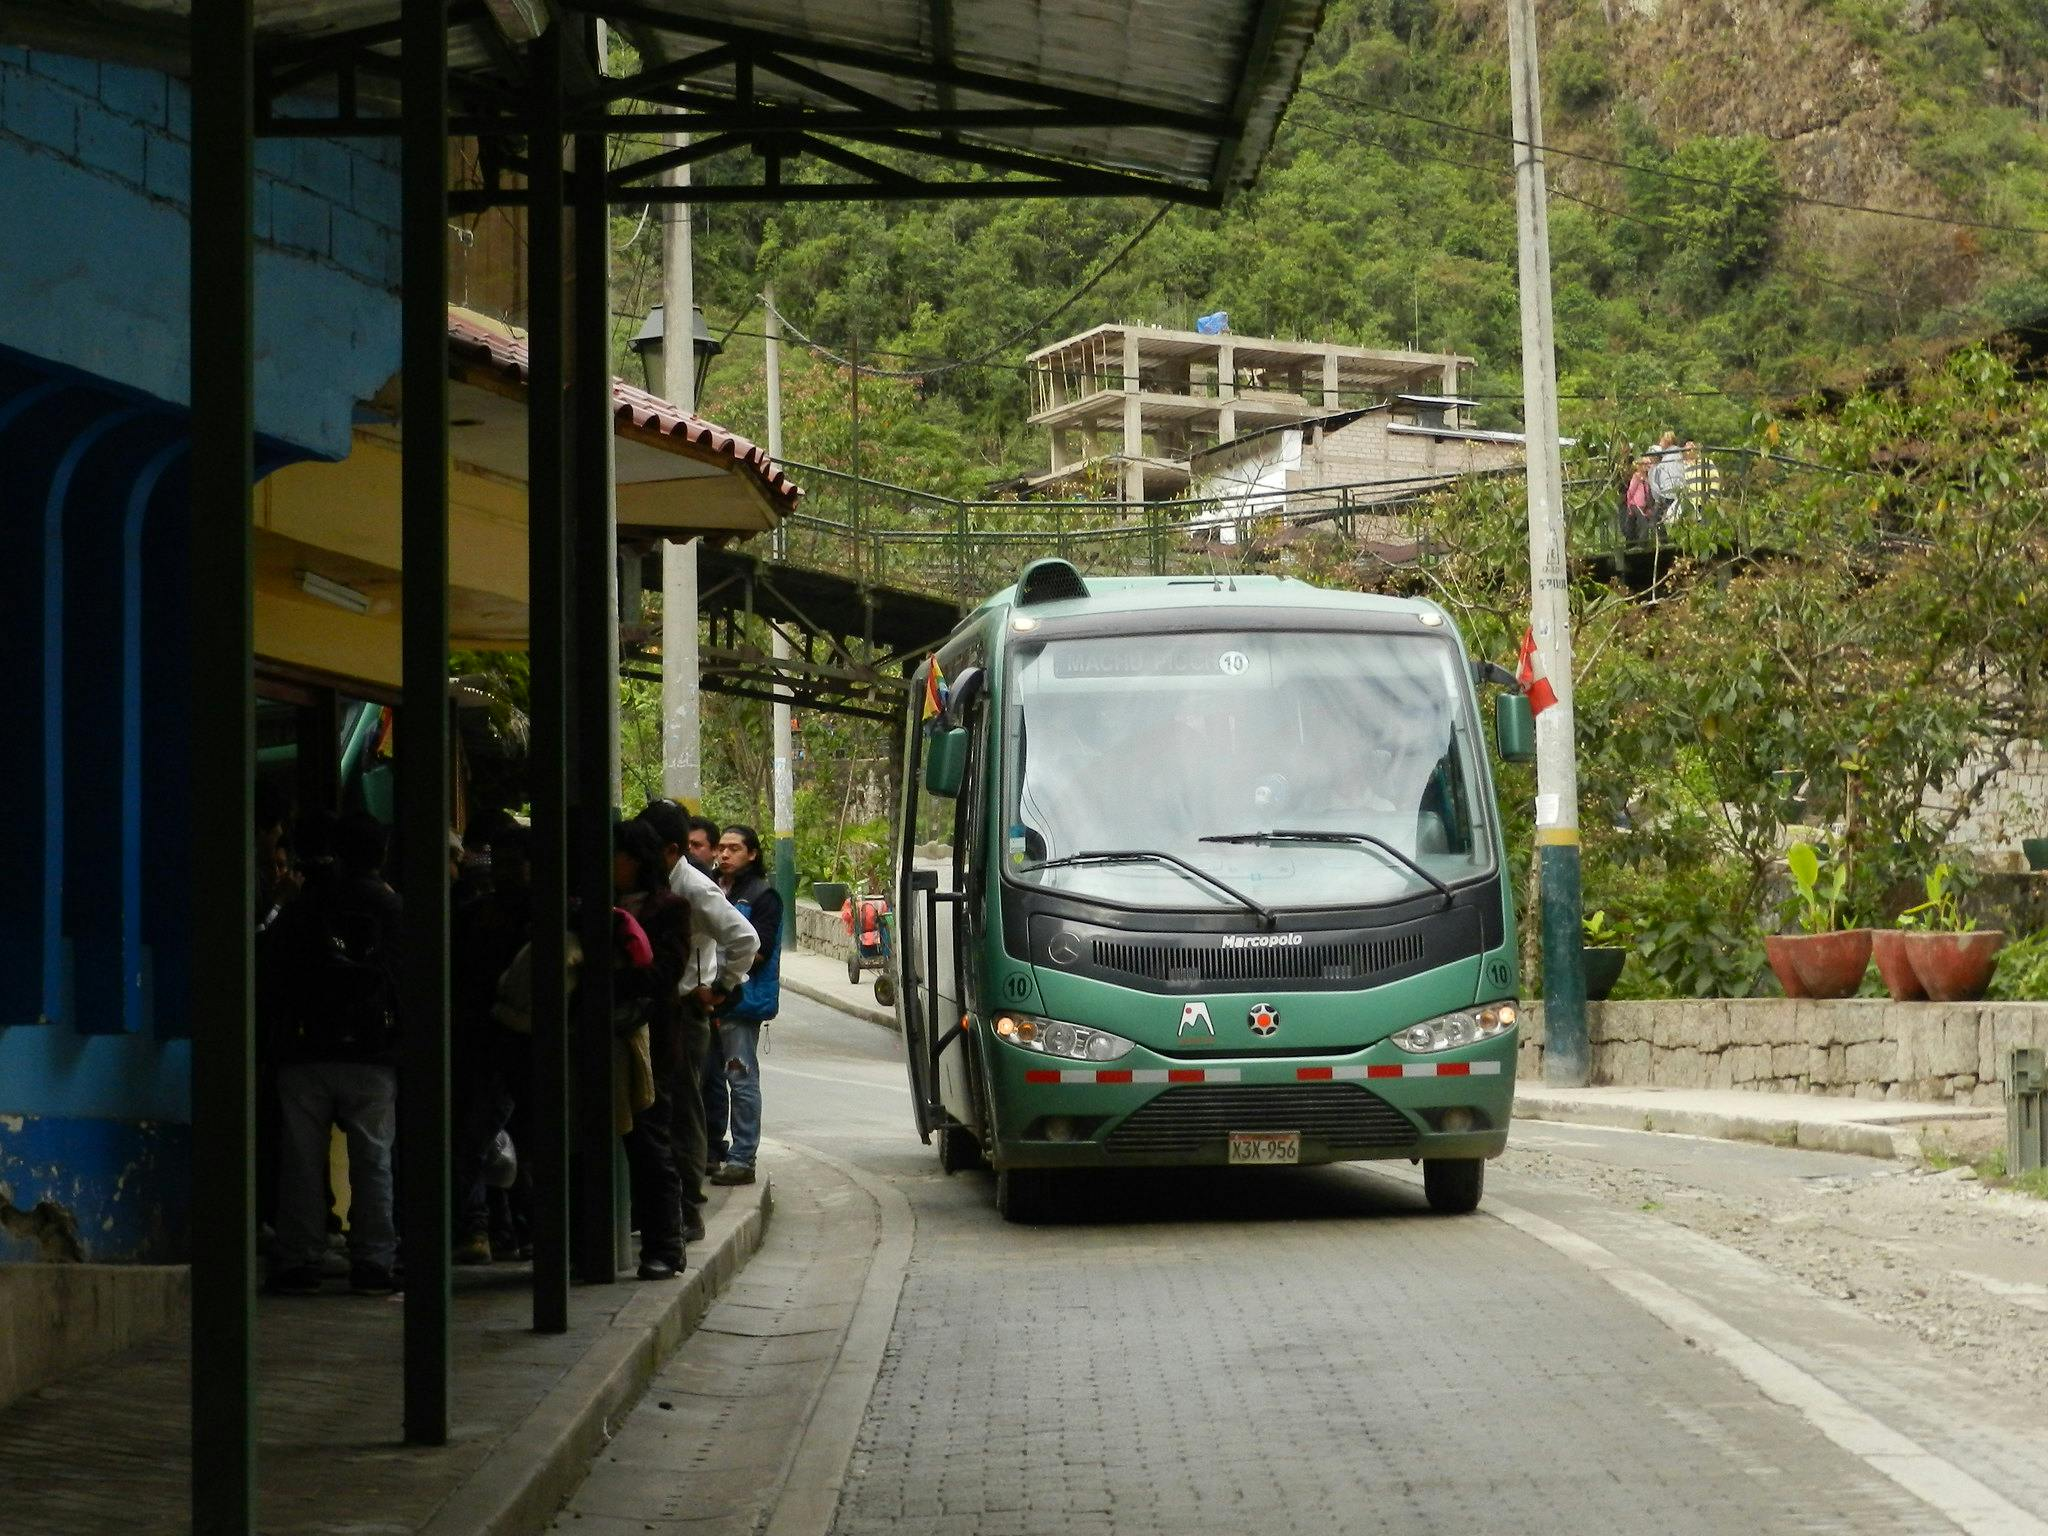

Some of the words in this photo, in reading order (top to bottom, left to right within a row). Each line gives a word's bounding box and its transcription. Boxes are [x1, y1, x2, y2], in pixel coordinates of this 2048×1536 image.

[1067, 654, 1144, 672] MACHU
[1224, 655, 1244, 671] 10
[1221, 933, 1303, 949] Marcopolo
[1491, 965, 1508, 984] 10
[1008, 977, 1027, 997] 10
[1232, 1140, 1296, 1160] X3X-956
